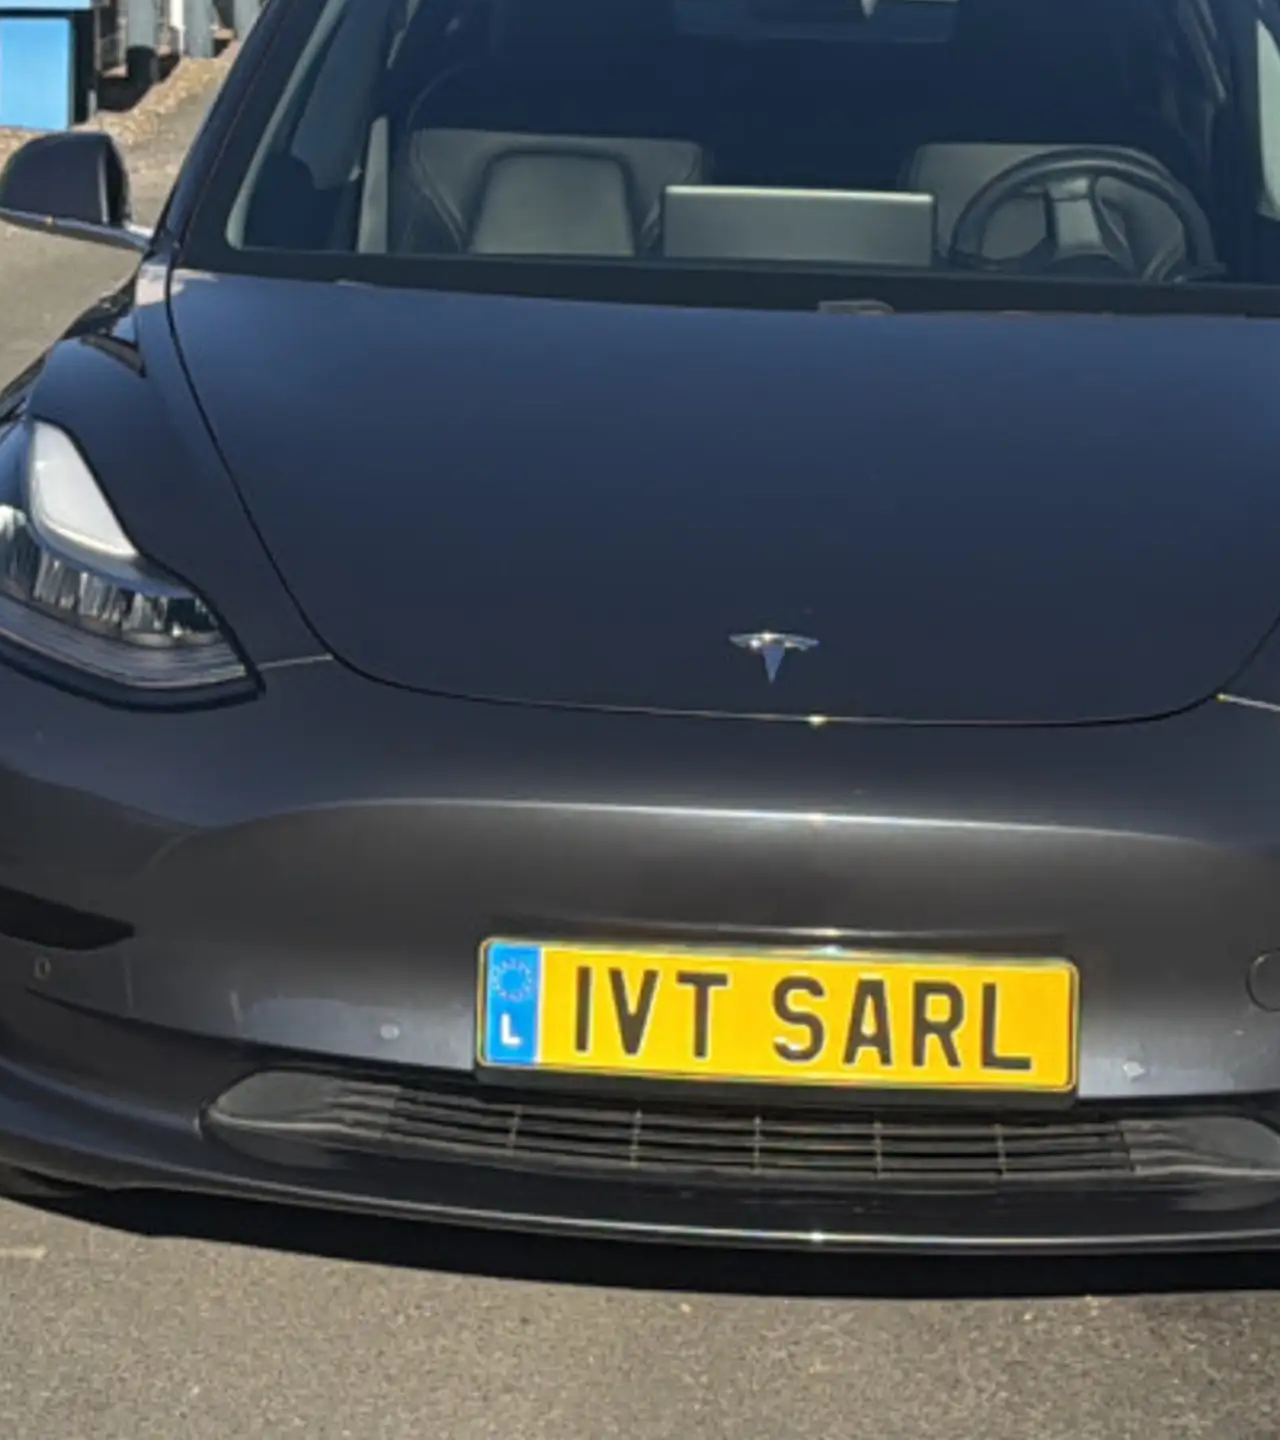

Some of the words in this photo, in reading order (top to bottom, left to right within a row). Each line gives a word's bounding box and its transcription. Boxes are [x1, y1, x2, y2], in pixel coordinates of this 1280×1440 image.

[501, 1013, 521, 1045] L
[574, 965, 728, 1058] IVT
[772, 976, 1032, 1070] SARL
